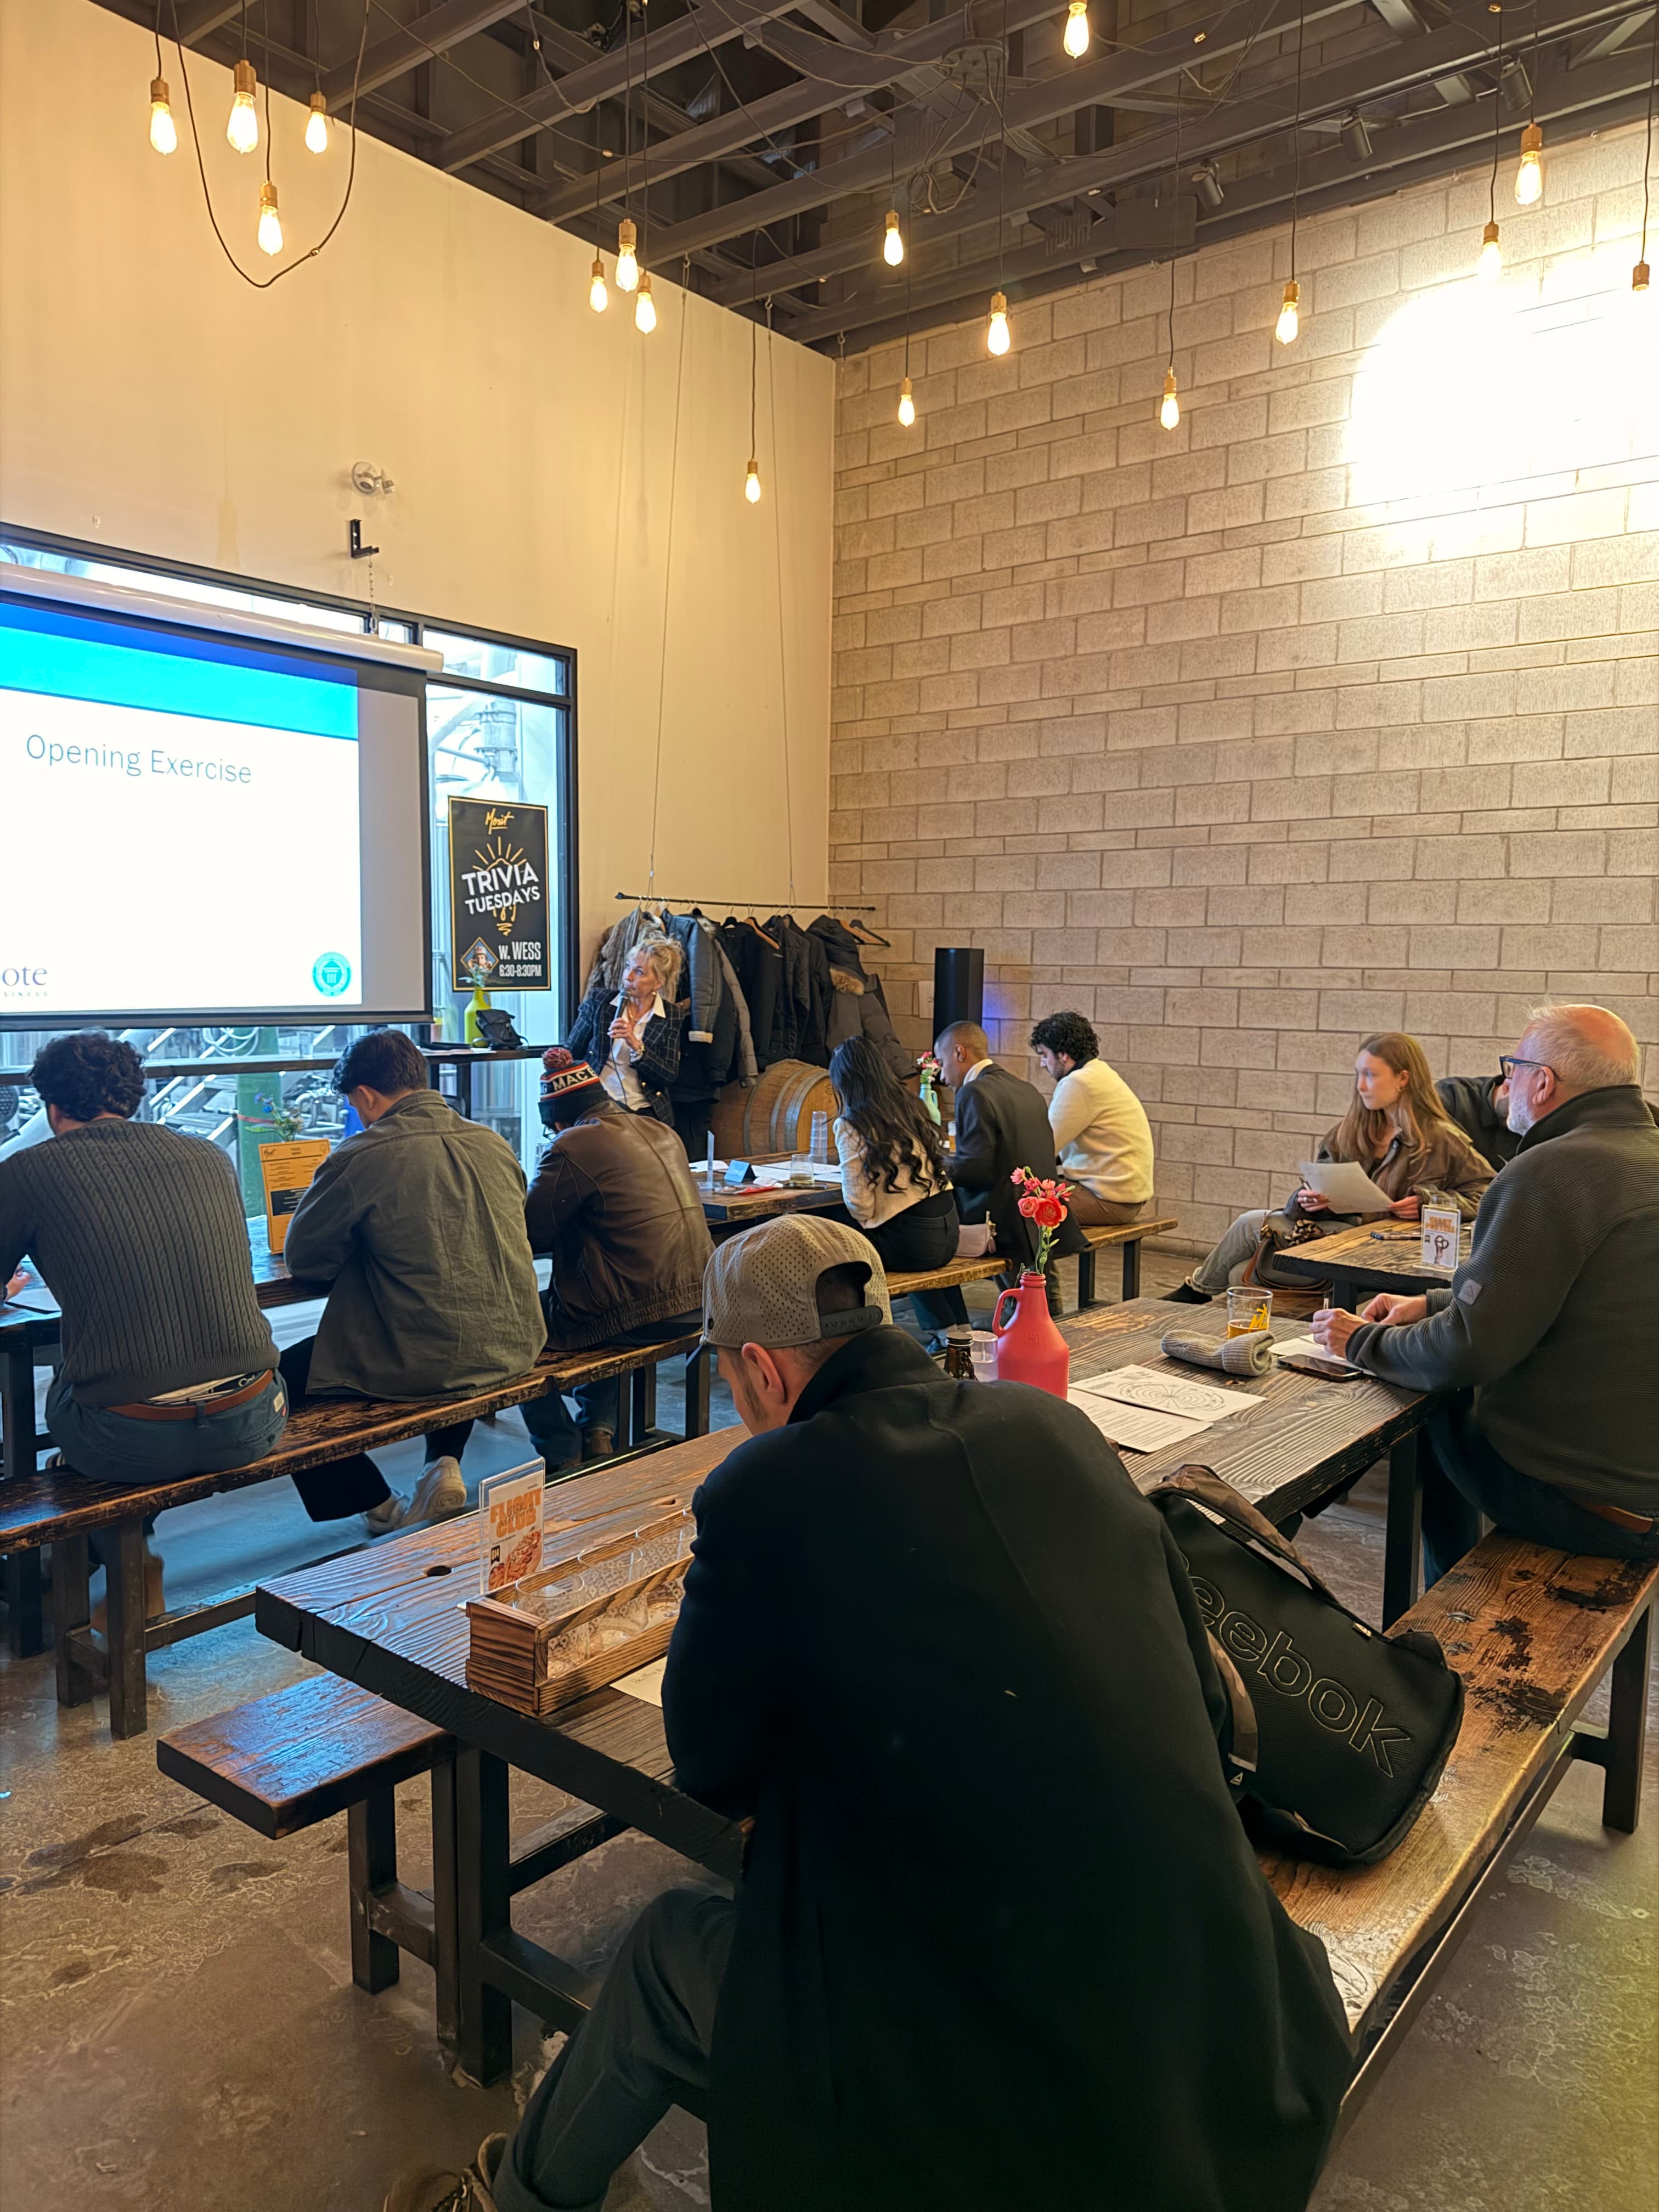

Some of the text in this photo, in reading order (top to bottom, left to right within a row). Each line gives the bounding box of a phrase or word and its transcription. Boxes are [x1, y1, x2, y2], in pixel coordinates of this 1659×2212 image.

[26, 734, 252, 783] Opening Exercise
[485, 808, 515, 835] Merit
[461, 862, 539, 895] TRIVIA
[465, 885, 540, 915] TUESDAYS
[511, 941, 541, 960] WESS
[2, 966, 48, 986] ote
[496, 1508, 536, 1538] CLUB
[1180, 1550, 1410, 1778] eebok
